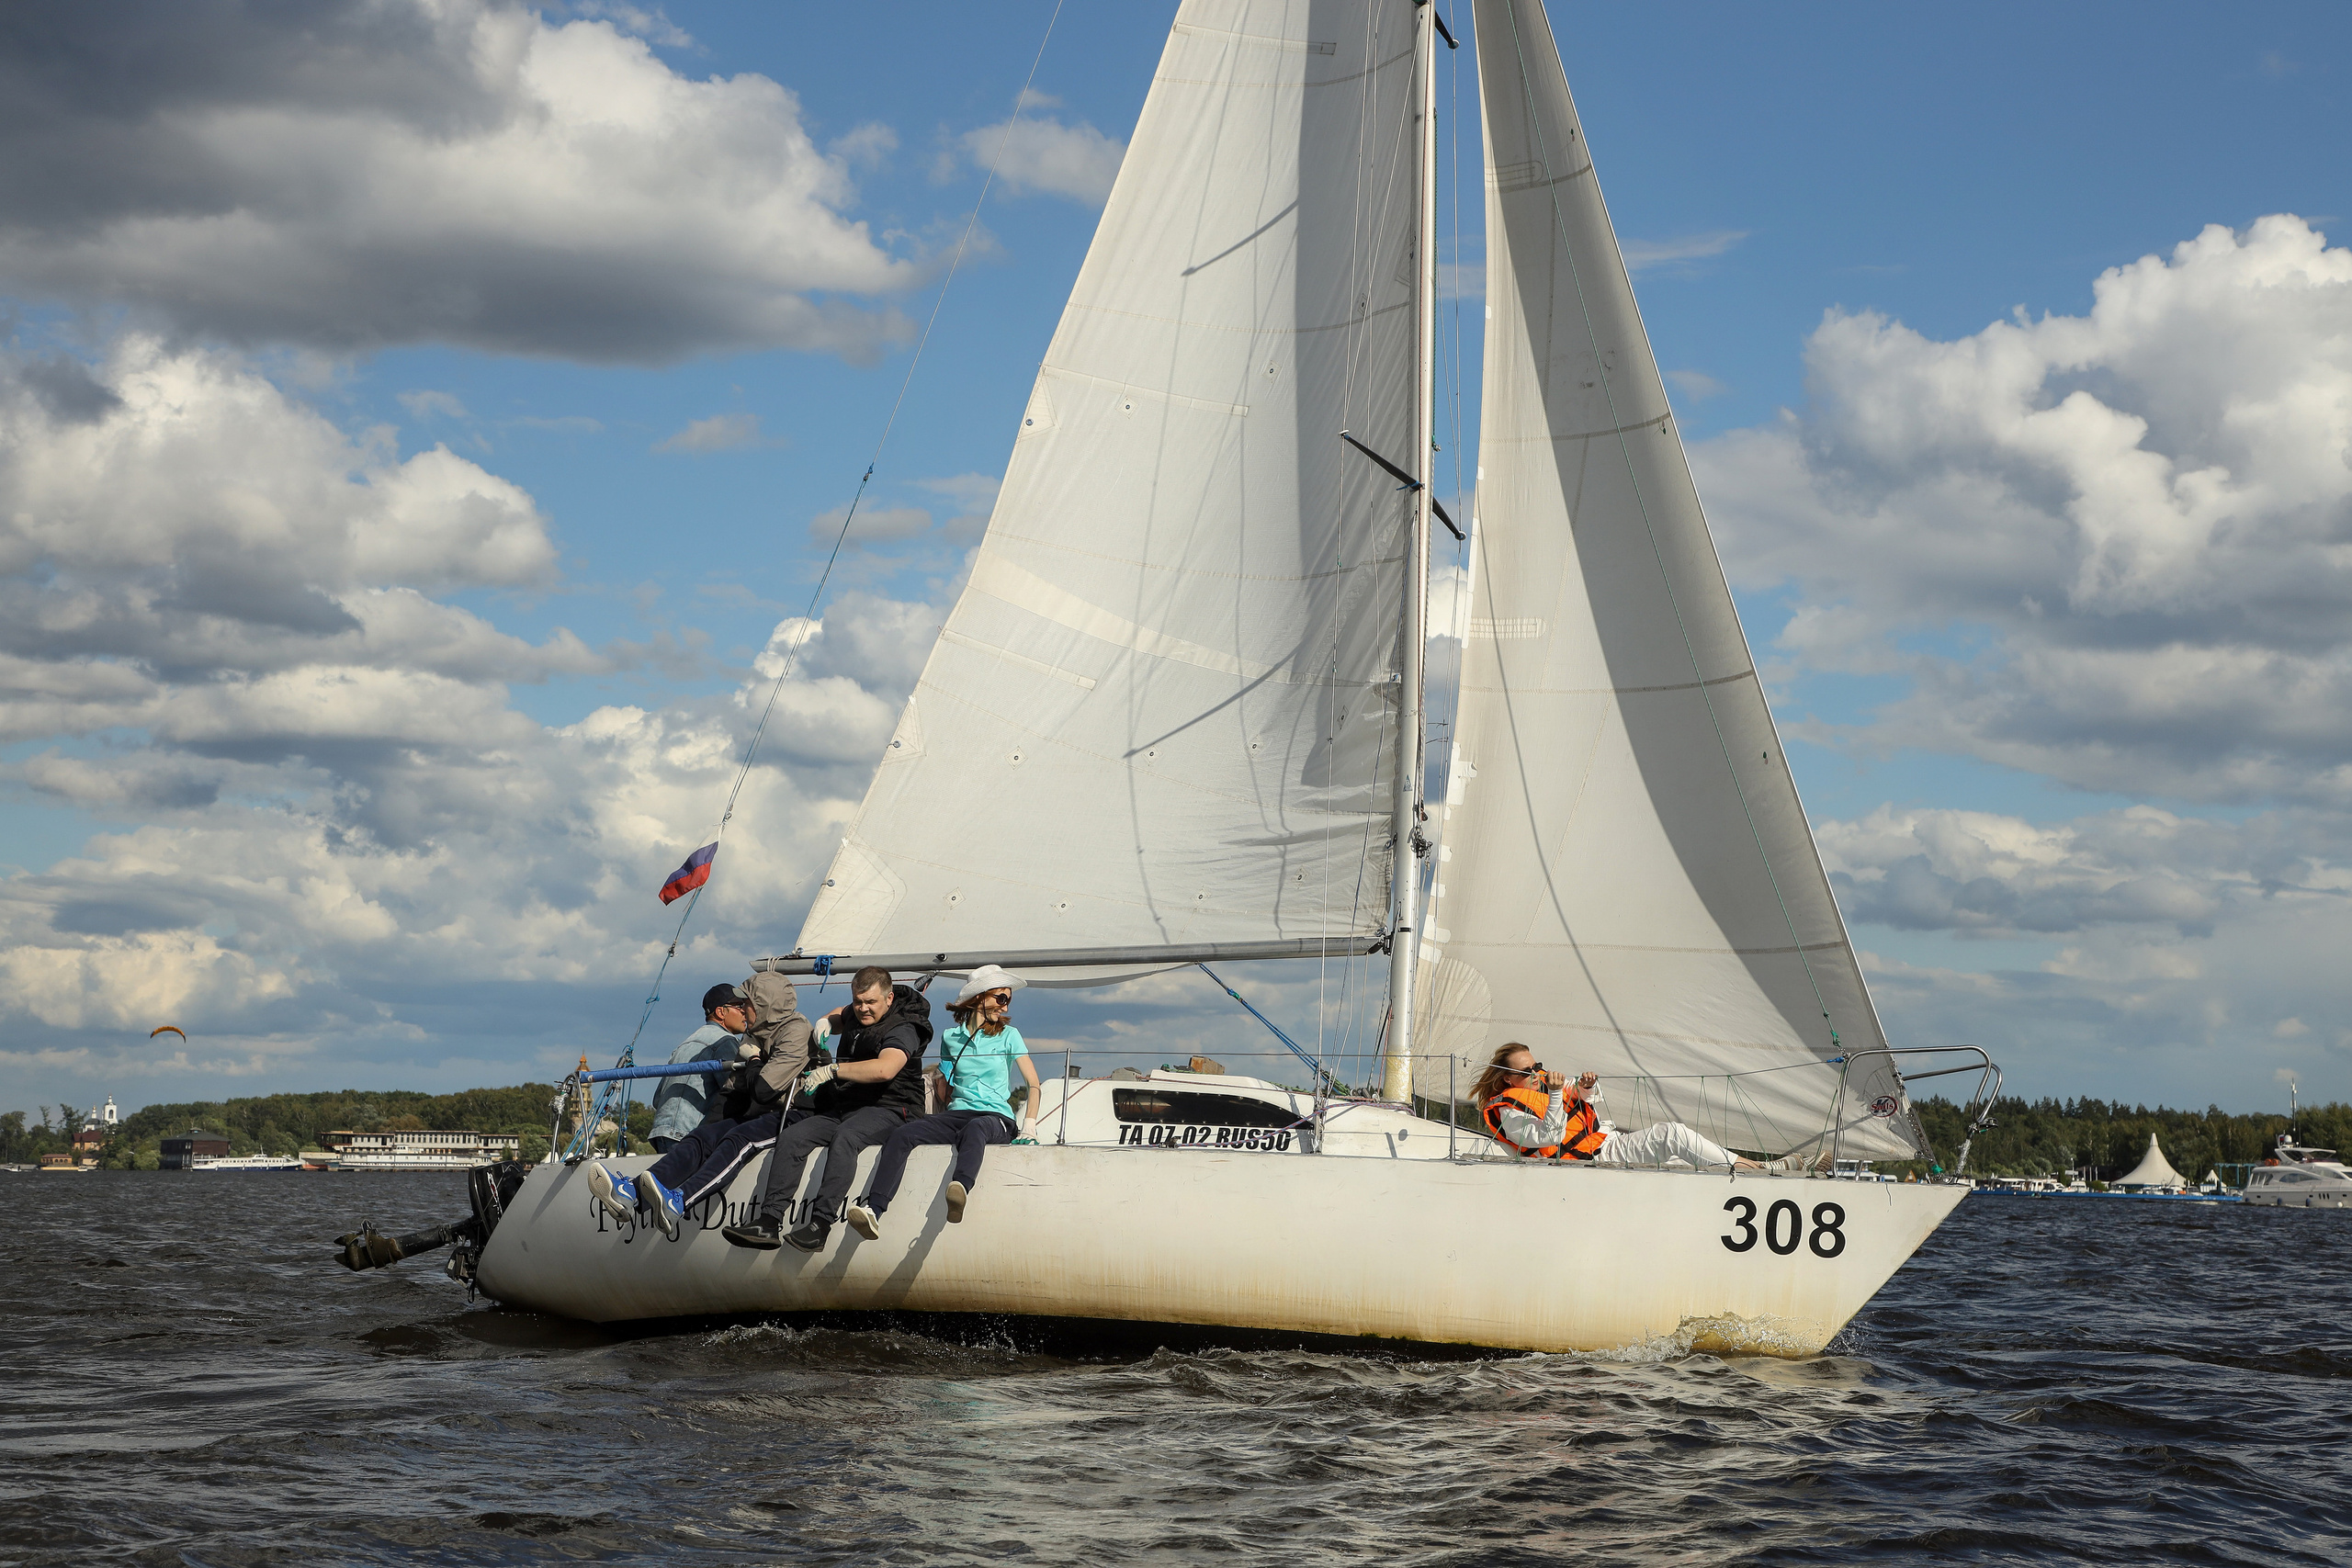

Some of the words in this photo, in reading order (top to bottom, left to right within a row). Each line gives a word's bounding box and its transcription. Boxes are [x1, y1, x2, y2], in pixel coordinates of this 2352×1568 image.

[1871, 1102, 1894, 1111] Sails
[1119, 1125, 1143, 1145] TA
[1216, 1127, 1291, 1151] RUS50
[1721, 1196, 1846, 1258] 308
